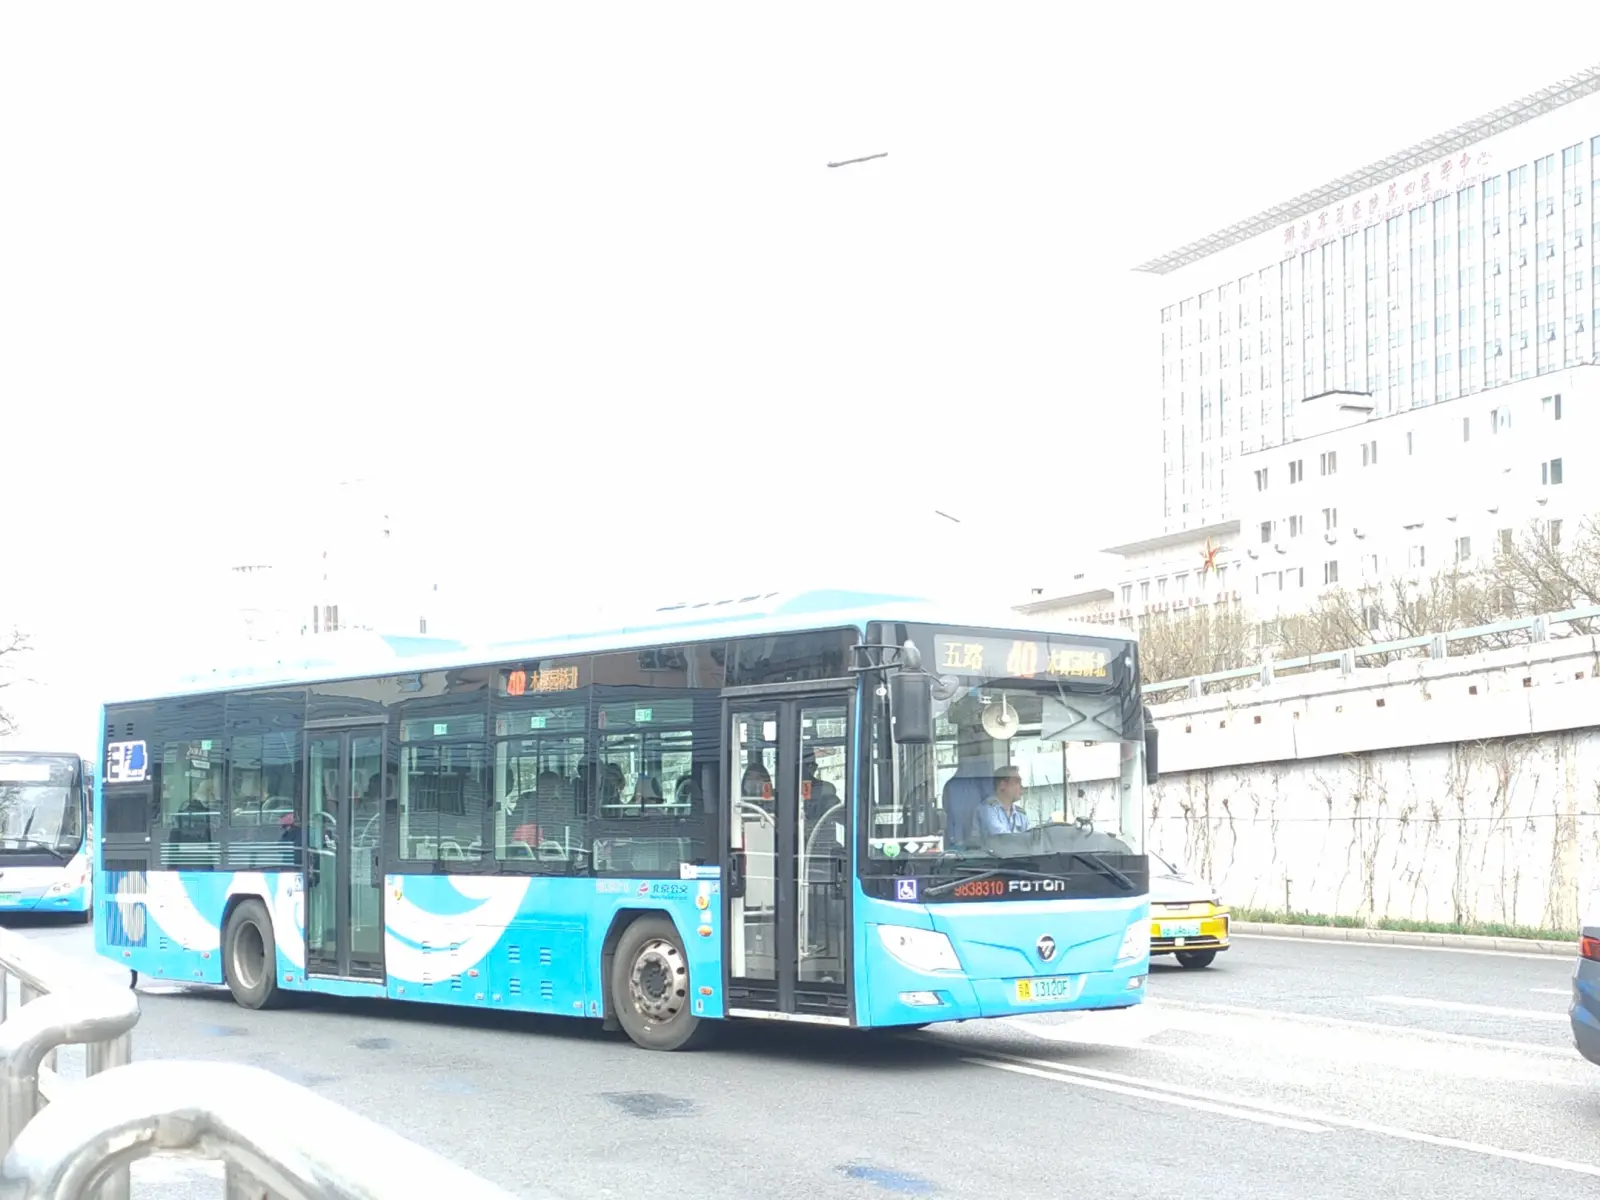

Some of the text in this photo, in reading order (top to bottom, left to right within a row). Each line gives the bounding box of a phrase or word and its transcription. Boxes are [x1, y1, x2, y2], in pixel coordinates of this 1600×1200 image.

[942, 641, 984, 670] 五路
[1006, 639, 1038, 678] 40
[507, 670, 526, 696] 40
[954, 879, 1065, 897] 9838310 FOTON
